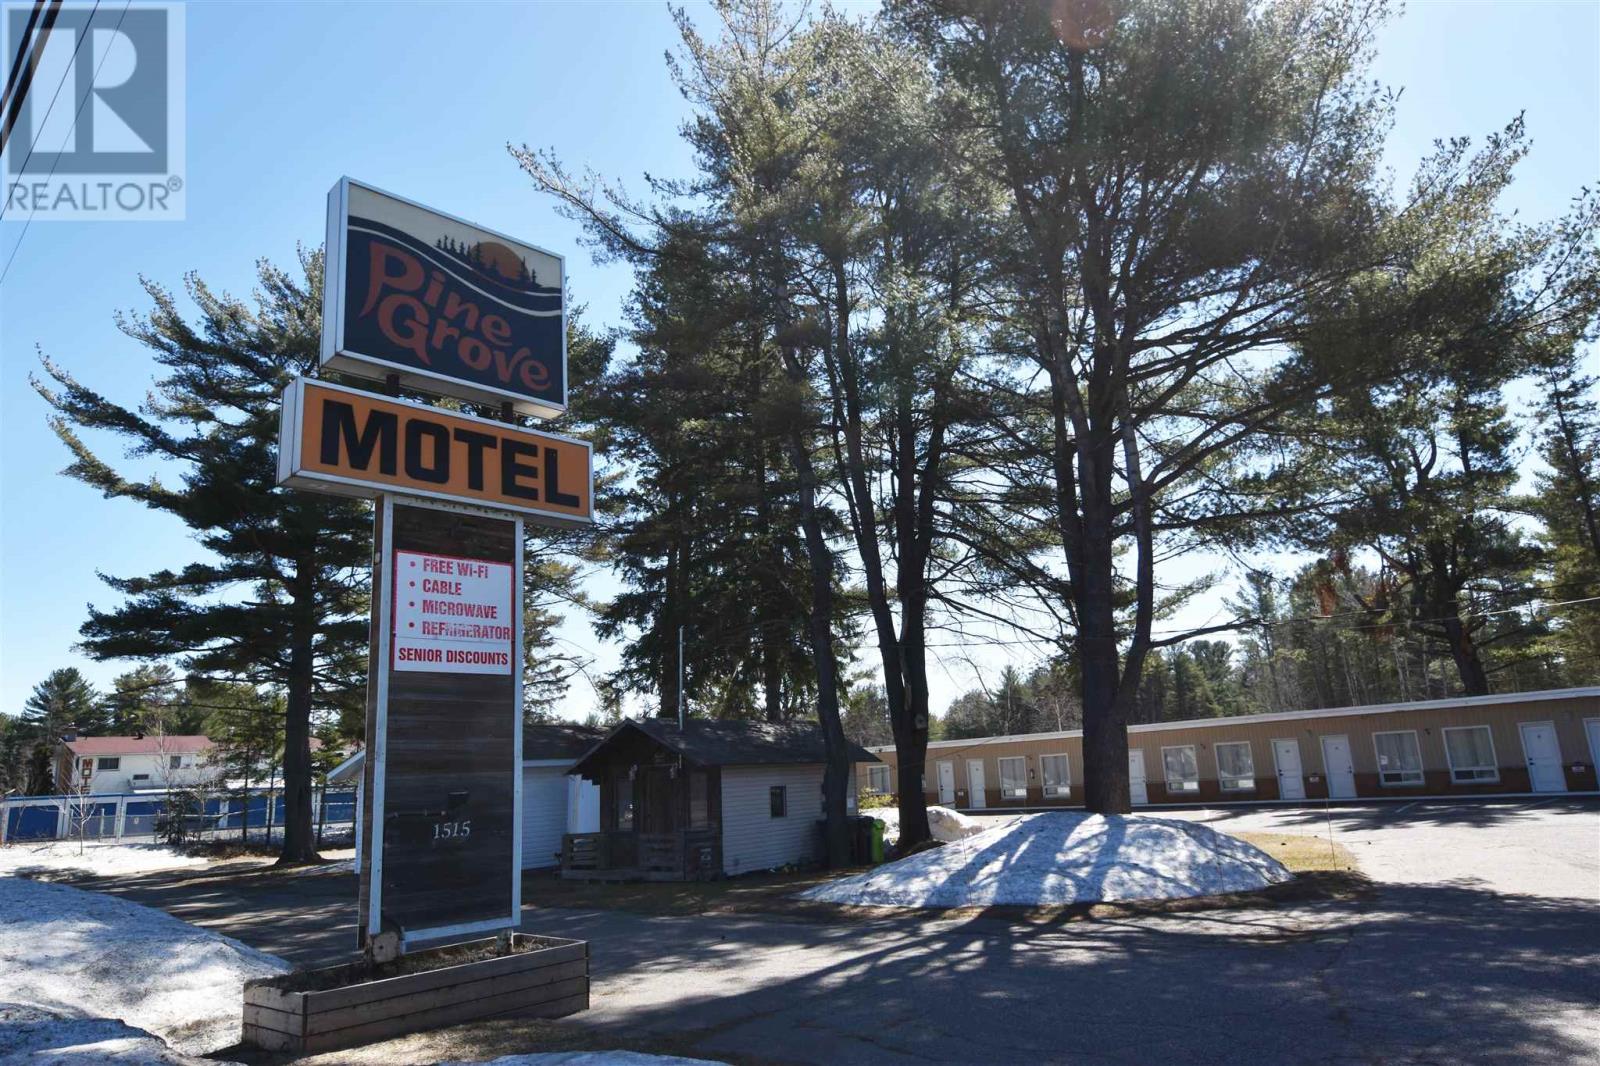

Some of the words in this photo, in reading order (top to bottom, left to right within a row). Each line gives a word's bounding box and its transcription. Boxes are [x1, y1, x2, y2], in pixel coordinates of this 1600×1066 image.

[358, 240, 512, 347] Pine
[377, 294, 550, 391] Grove
[320, 399, 580, 508] MOTEL
[423, 558, 453, 575] FREE
[456, 561, 488, 579] Wi-Fi
[423, 578, 462, 596] CABLE
[422, 599, 497, 619] MICROWAVE
[398, 647, 443, 663] SENIOR
[446, 650, 508, 665] DISCOUNTS
[433, 820, 471, 840] 1515
